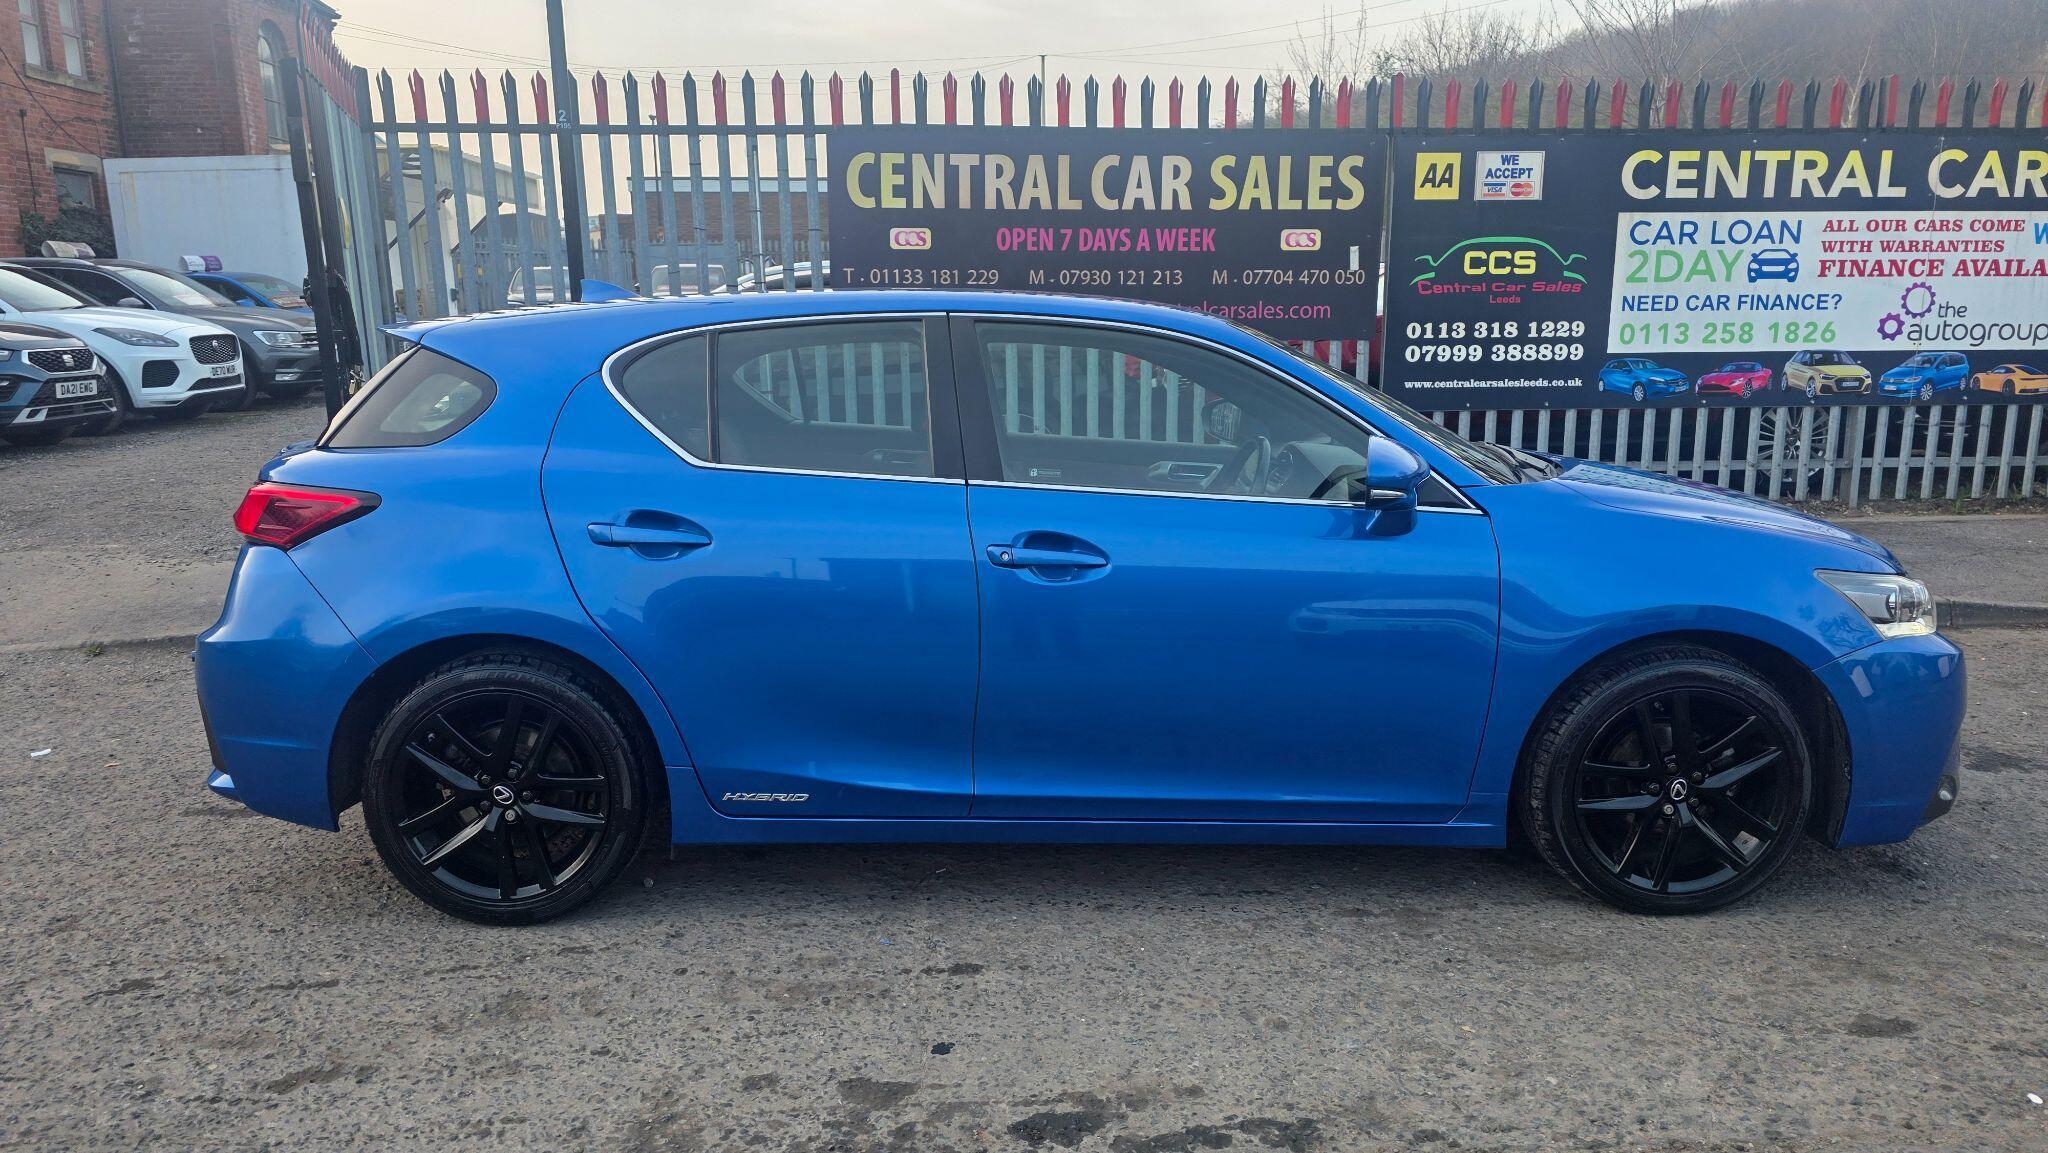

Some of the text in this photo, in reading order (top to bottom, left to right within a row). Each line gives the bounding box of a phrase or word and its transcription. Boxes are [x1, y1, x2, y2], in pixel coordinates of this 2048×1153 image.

[558, 110, 567, 122] 2
[1501, 155, 1519, 165] WE
[847, 152, 1365, 210] CENTRAL CAR SALES
[1420, 163, 1453, 188] AA
[1485, 168, 1533, 179] ACCEPT
[1621, 149, 2048, 199] CENTRAL CAR
[1629, 219, 1802, 246] CAR LOAN
[1822, 219, 2026, 232] ALL OUR CARS COME
[894, 230, 927, 247] CCS
[996, 227, 1216, 252] OPEN 7 DAYS A WEEK
[1285, 232, 1317, 247] CCS
[1821, 240, 2005, 252] WITH WARRANTIES
[1464, 250, 1537, 275] CCS
[1626, 249, 1745, 283] 2DAY
[1817, 259, 1945, 278] FINANCE
[870, 269, 924, 285] 01133
[931, 269, 959, 285] 181
[967, 269, 999, 285] 229
[1059, 270, 1111, 285] 07930
[1118, 270, 1145, 285] 121
[1152, 270, 1183, 285] 213
[1243, 270, 1294, 285] 07704
[1299, 270, 1330, 285] 470
[1335, 270, 1366, 285] 050
[1417, 280, 1583, 295] Central Car Sales
[1489, 295, 1521, 303] Leeds
[1621, 293, 1843, 312] NEED CAR FINANCE?
[1938, 301, 1967, 318] the
[1406, 320, 1586, 339] 0113 318 1229
[1619, 321, 1837, 345] 0113 258 1826
[1907, 320, 2048, 347] autogroup
[1404, 343, 1585, 362] 07999 388899
[60, 382, 94, 395] DA21 EWG
[1404, 378, 1583, 389] www.centralcarsalesleeds.co.uk
[722, 792, 810, 801] HYBRID
